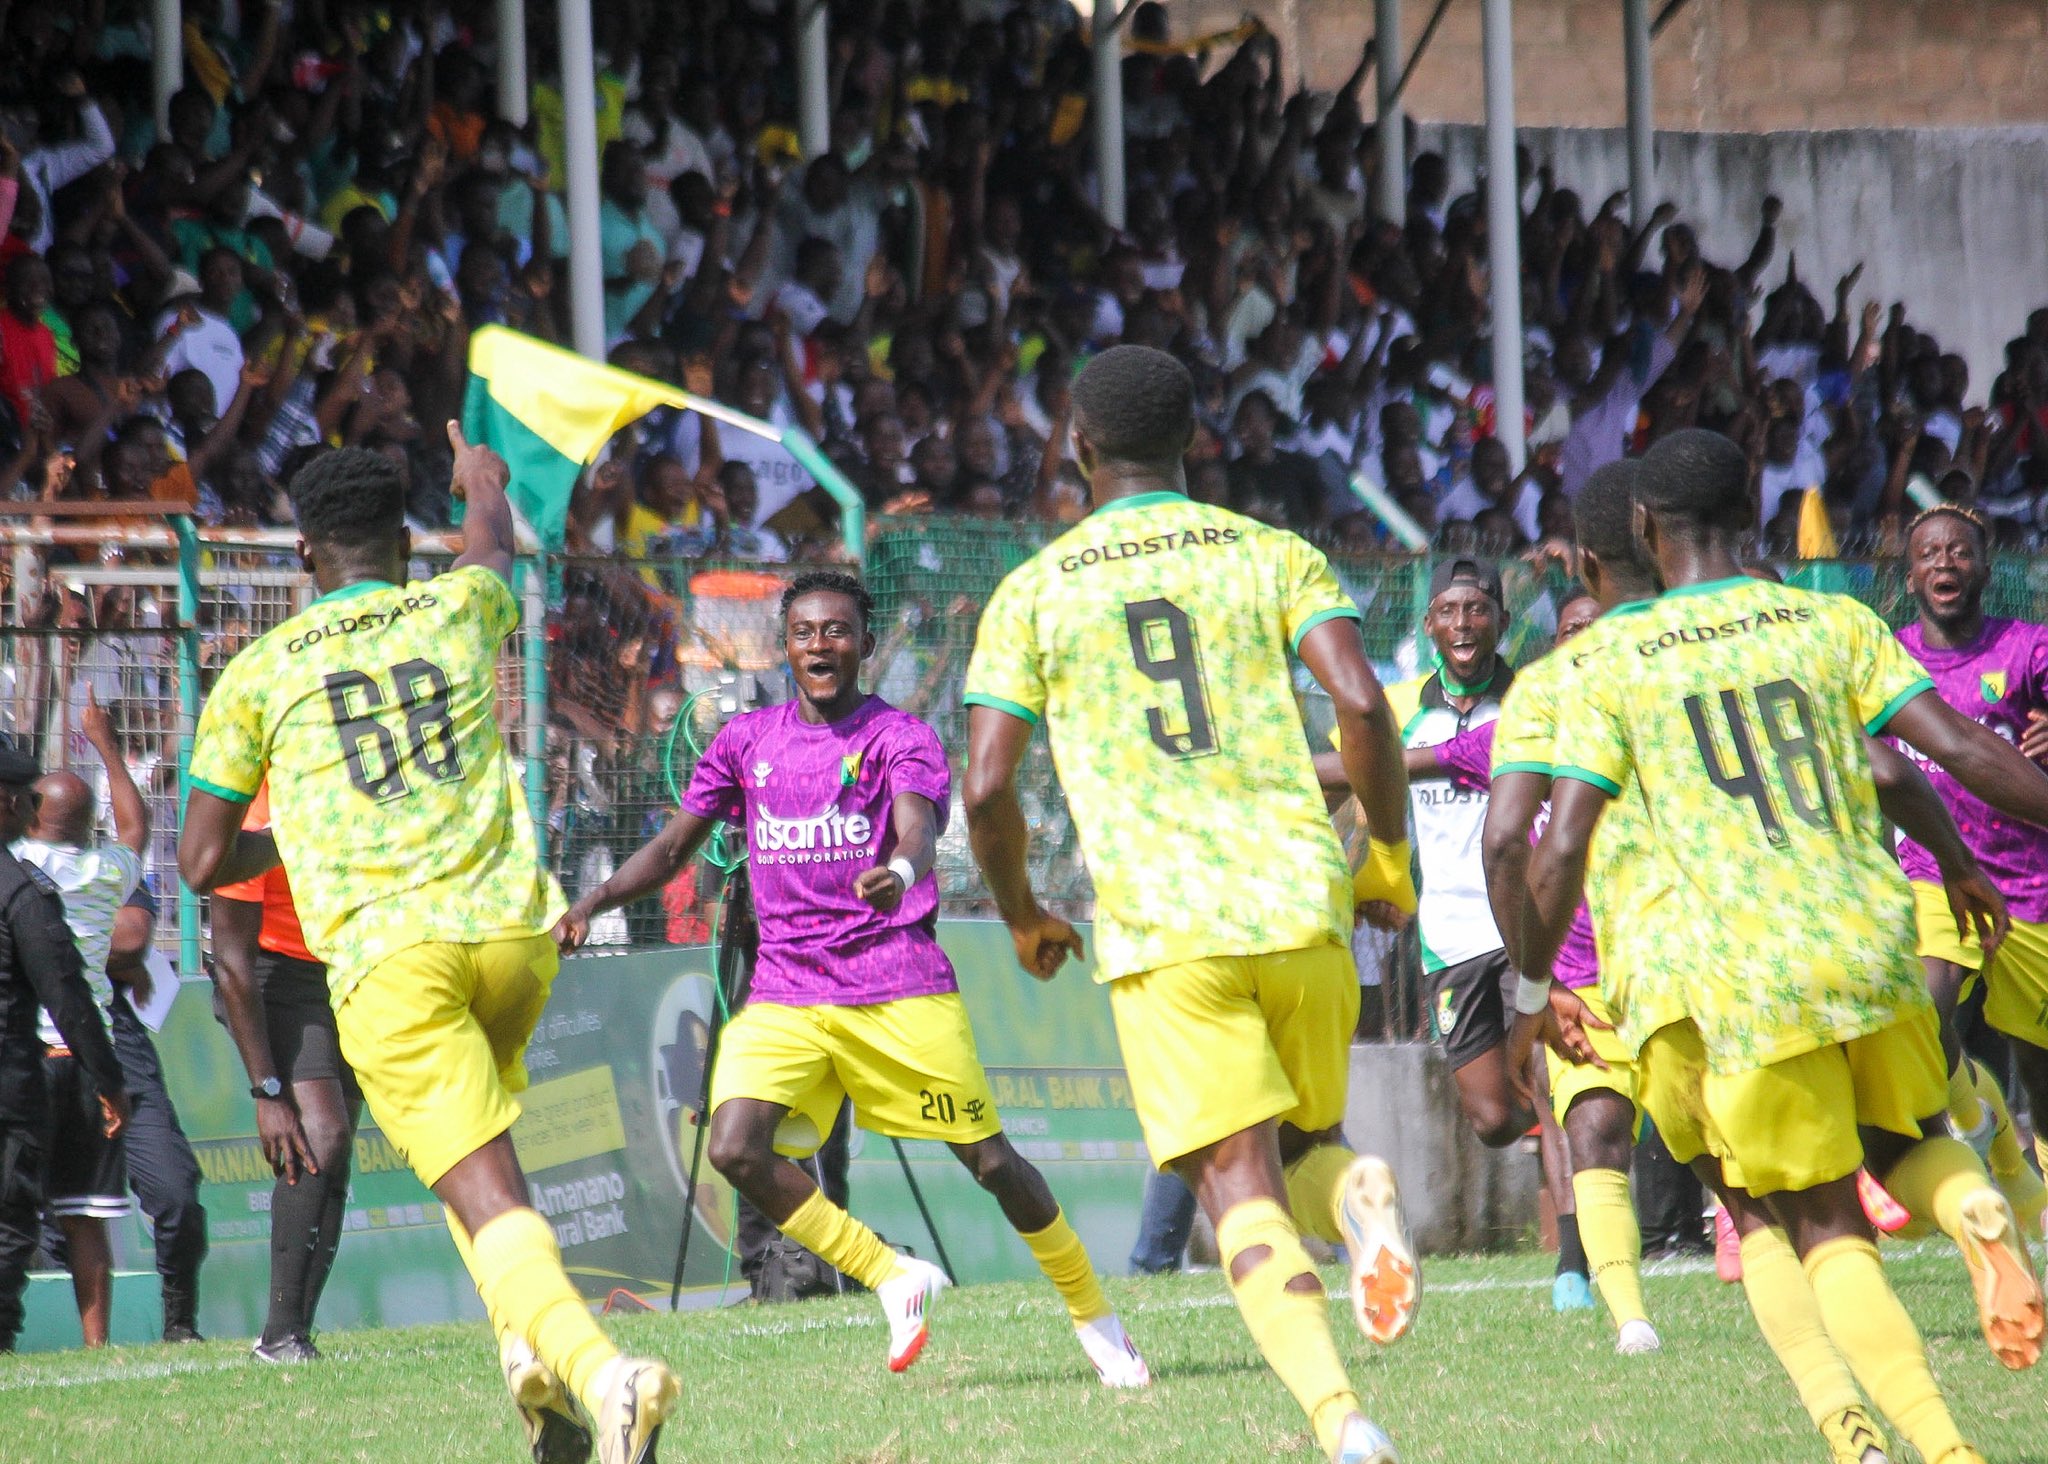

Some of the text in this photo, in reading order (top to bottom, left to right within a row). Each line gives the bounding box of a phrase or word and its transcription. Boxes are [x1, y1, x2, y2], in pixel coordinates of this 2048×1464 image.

[1061, 528, 1239, 573] GOLDSTARS
[288, 594, 437, 653] GOLDSTARS
[1639, 608, 1812, 656] GOLDSTARS
[1125, 598, 1220, 761] 9
[323, 658, 466, 805] 68
[1683, 678, 1840, 849] 48
[756, 808, 871, 851] asante
[778, 848, 875, 865] CORPORATION
[919, 1090, 956, 1124] 20
[530, 1171, 625, 1217] Amanano
[557, 1203, 629, 1249] ural Bank
